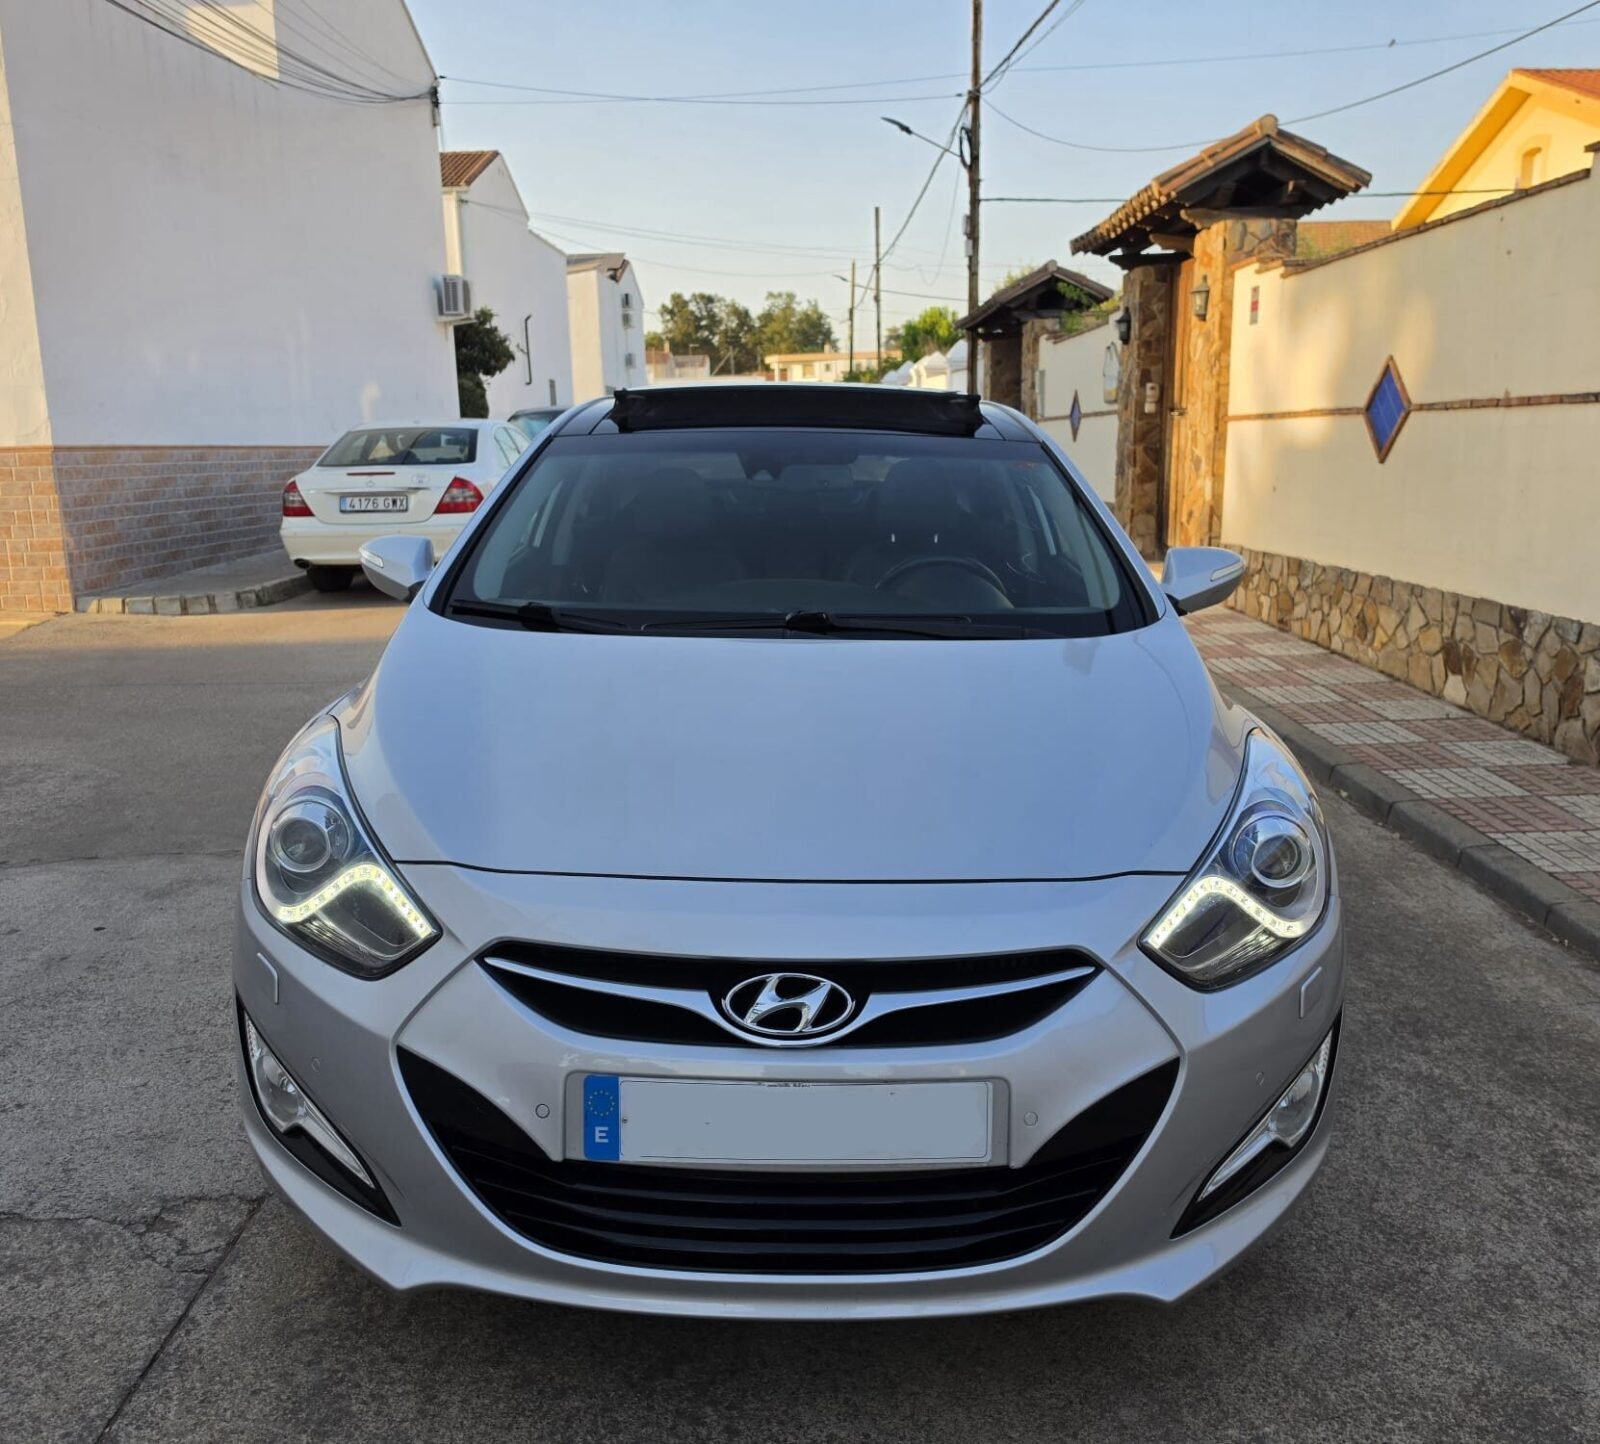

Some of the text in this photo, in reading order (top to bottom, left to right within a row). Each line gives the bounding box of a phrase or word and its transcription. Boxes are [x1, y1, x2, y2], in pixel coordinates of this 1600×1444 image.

[349, 498, 405, 509] 4176 GWX
[594, 1126, 609, 1143] E
